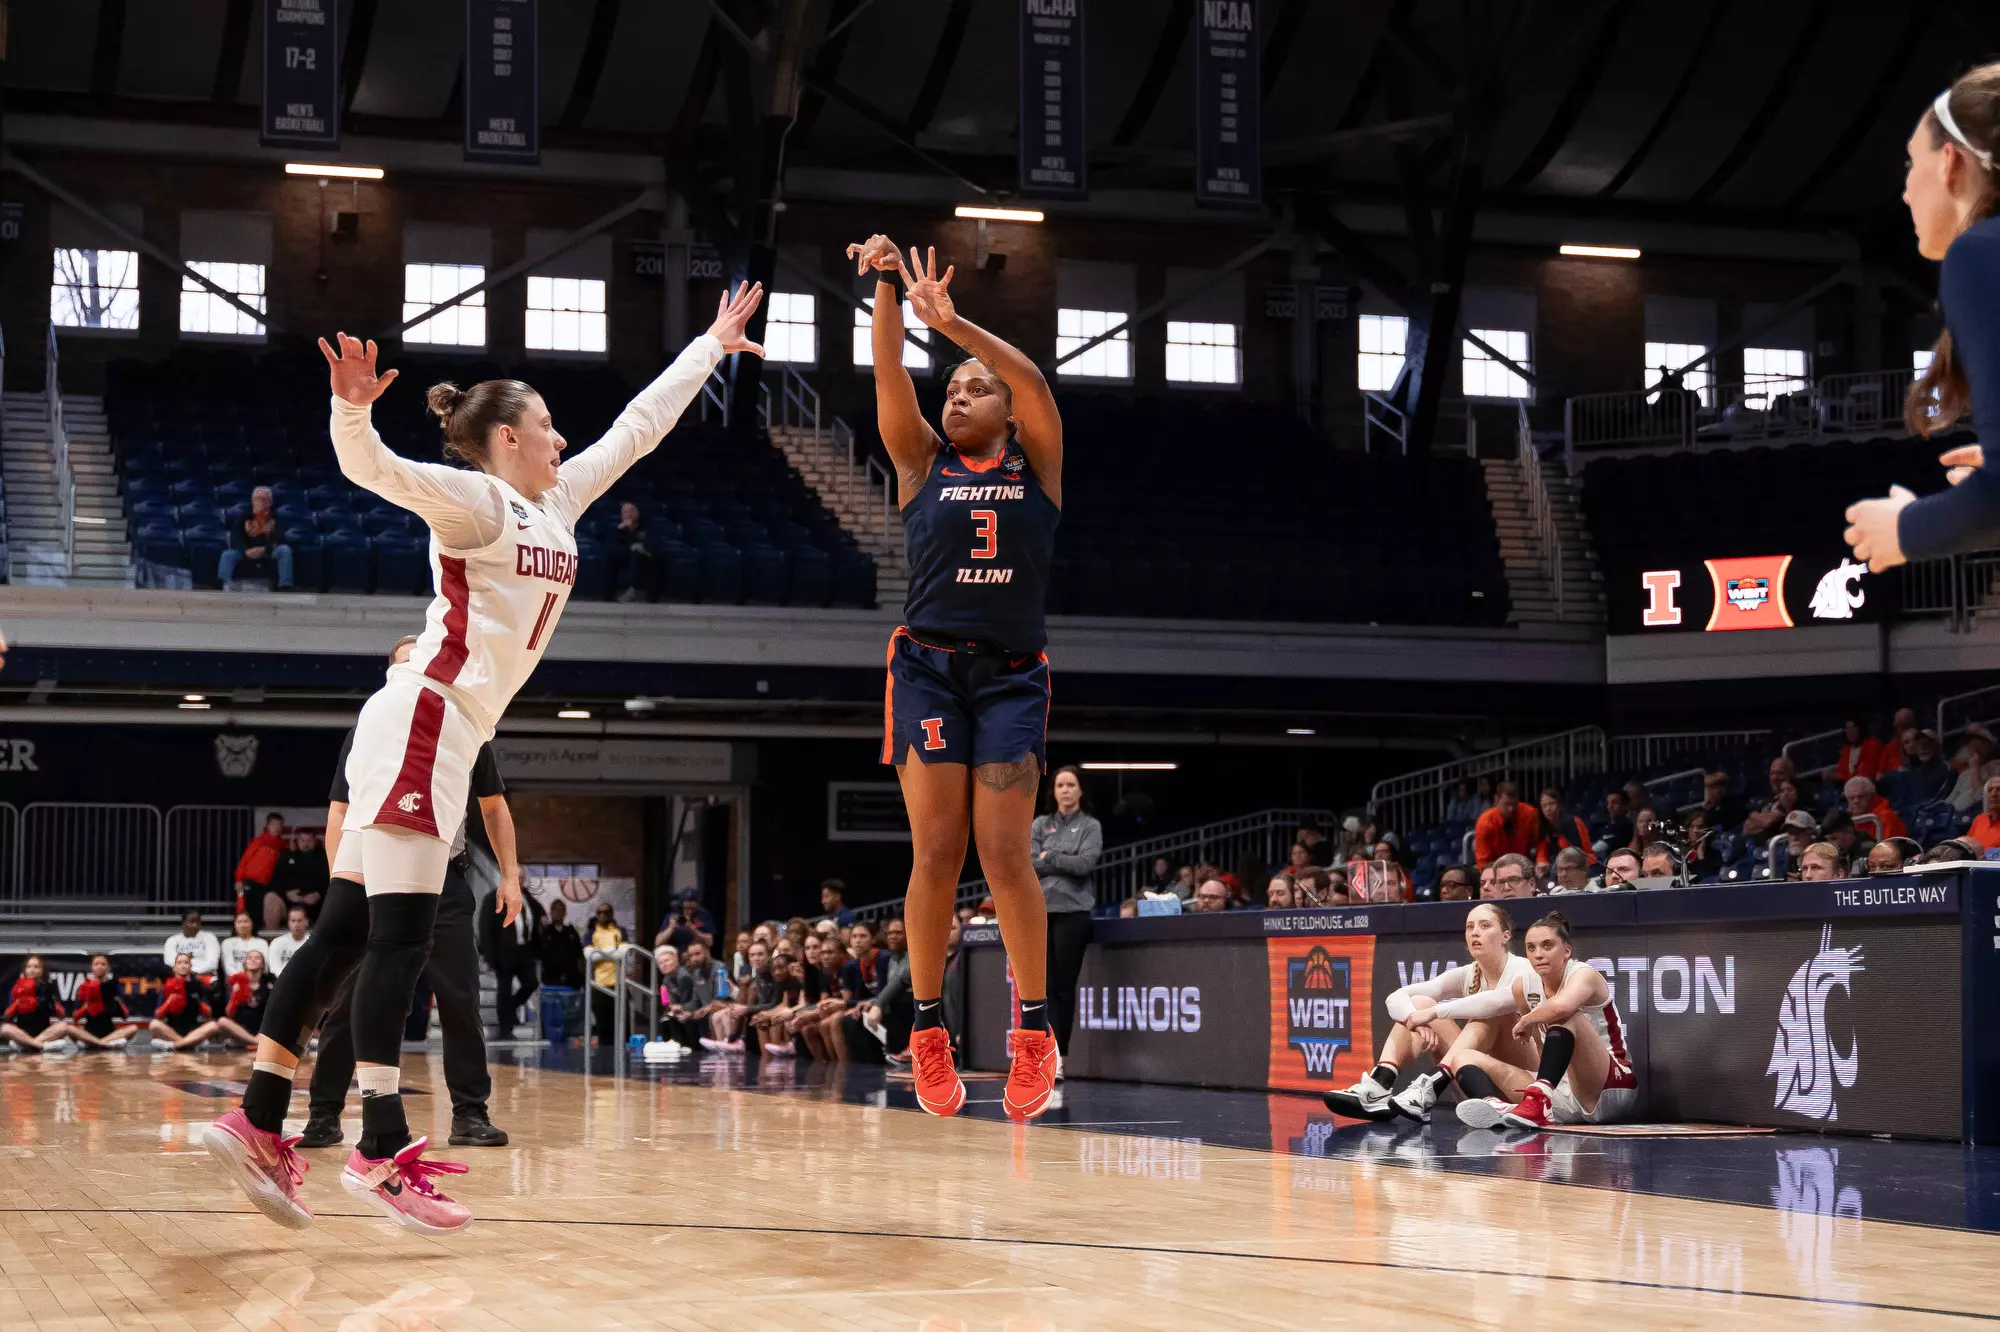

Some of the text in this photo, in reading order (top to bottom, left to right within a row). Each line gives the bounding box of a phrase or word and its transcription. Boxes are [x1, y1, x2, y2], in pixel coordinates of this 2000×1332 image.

[1203, 0, 1252, 30] NCAA
[285, 47, 316, 70] 17-2
[691, 260, 723, 278] 202
[939, 485, 1024, 501] FIGHTING
[971, 510, 998, 559] 3
[955, 568, 1013, 584] ILLINI
[526, 591, 559, 650] 11
[1834, 886, 1947, 906] THE BUTLER WAY
[1264, 917, 1291, 930] HINKLE
[1293, 915, 1343, 930] FIELDHOUSE
[1080, 986, 1201, 1032] ILLINOIS
[1289, 998, 1349, 1029] WBIT
